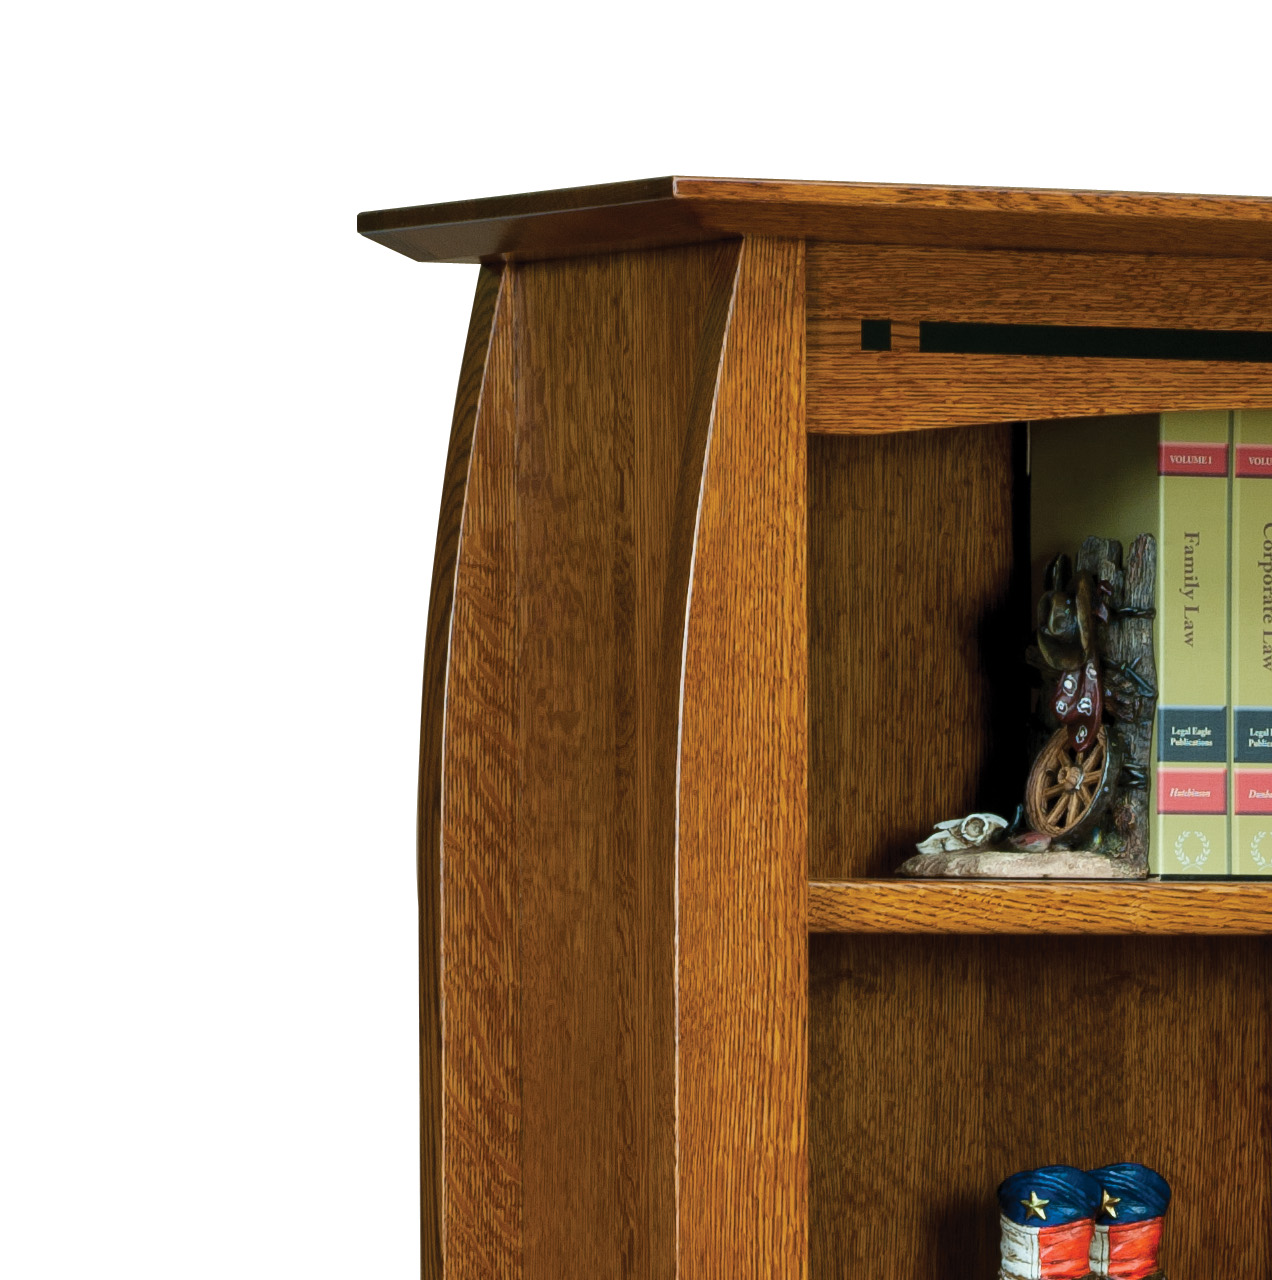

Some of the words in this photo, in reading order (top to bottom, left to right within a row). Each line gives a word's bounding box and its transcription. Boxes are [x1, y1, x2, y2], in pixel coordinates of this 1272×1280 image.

[1170, 455, 1207, 465] VOLUME
[1207, 456, 1213, 465] I
[1179, 532, 1200, 600] Family
[1184, 605, 1200, 647] Law
[1171, 727, 1190, 737] Legal
[1192, 727, 1212, 737] Eagle
[1250, 728, 1269, 738] Legal
[1170, 738, 1213, 747] Publications
